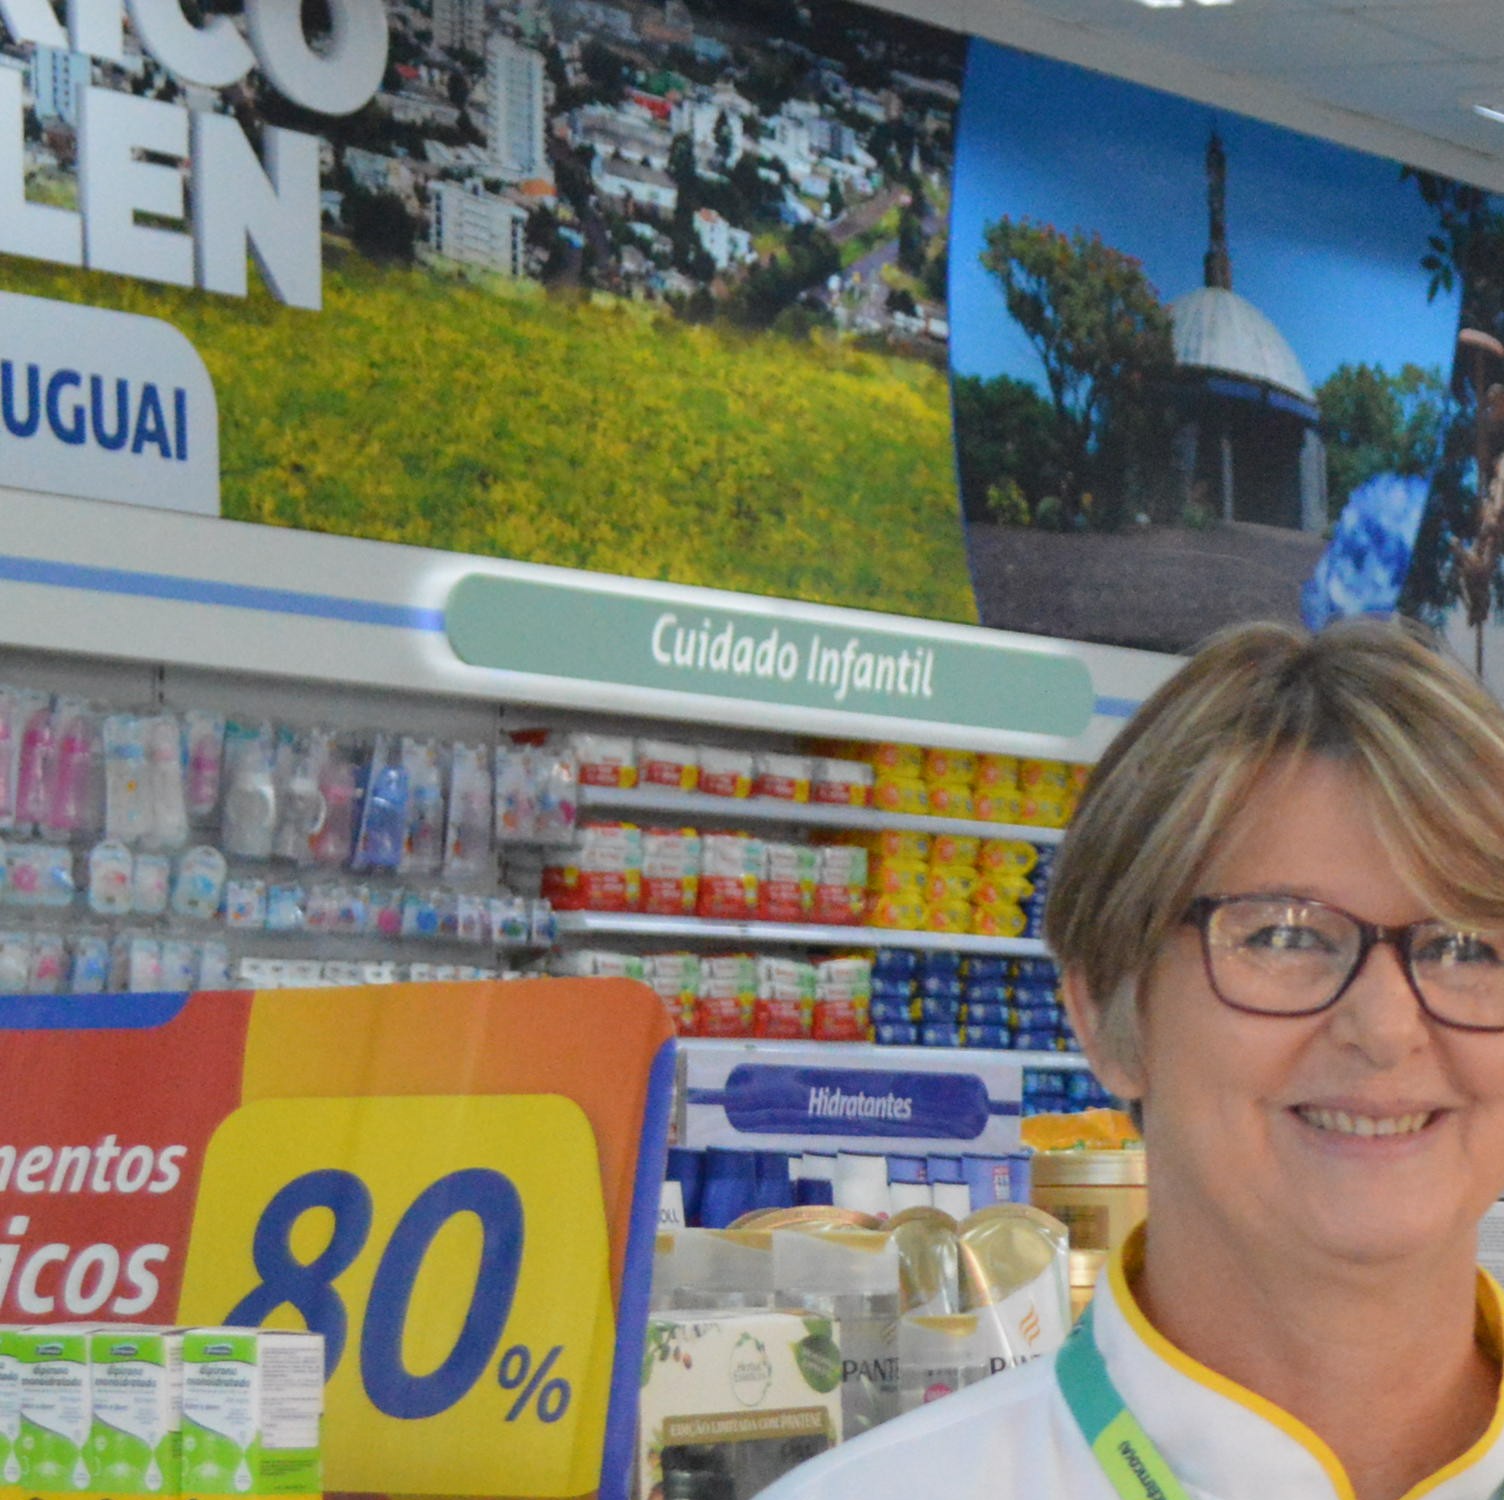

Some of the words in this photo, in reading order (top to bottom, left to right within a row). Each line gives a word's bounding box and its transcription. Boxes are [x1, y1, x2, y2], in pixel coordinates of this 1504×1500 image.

[652, 613, 798, 680] Cuidado
[807, 635, 934, 700] Infantil
[809, 1088, 912, 1121] Hidratantes
